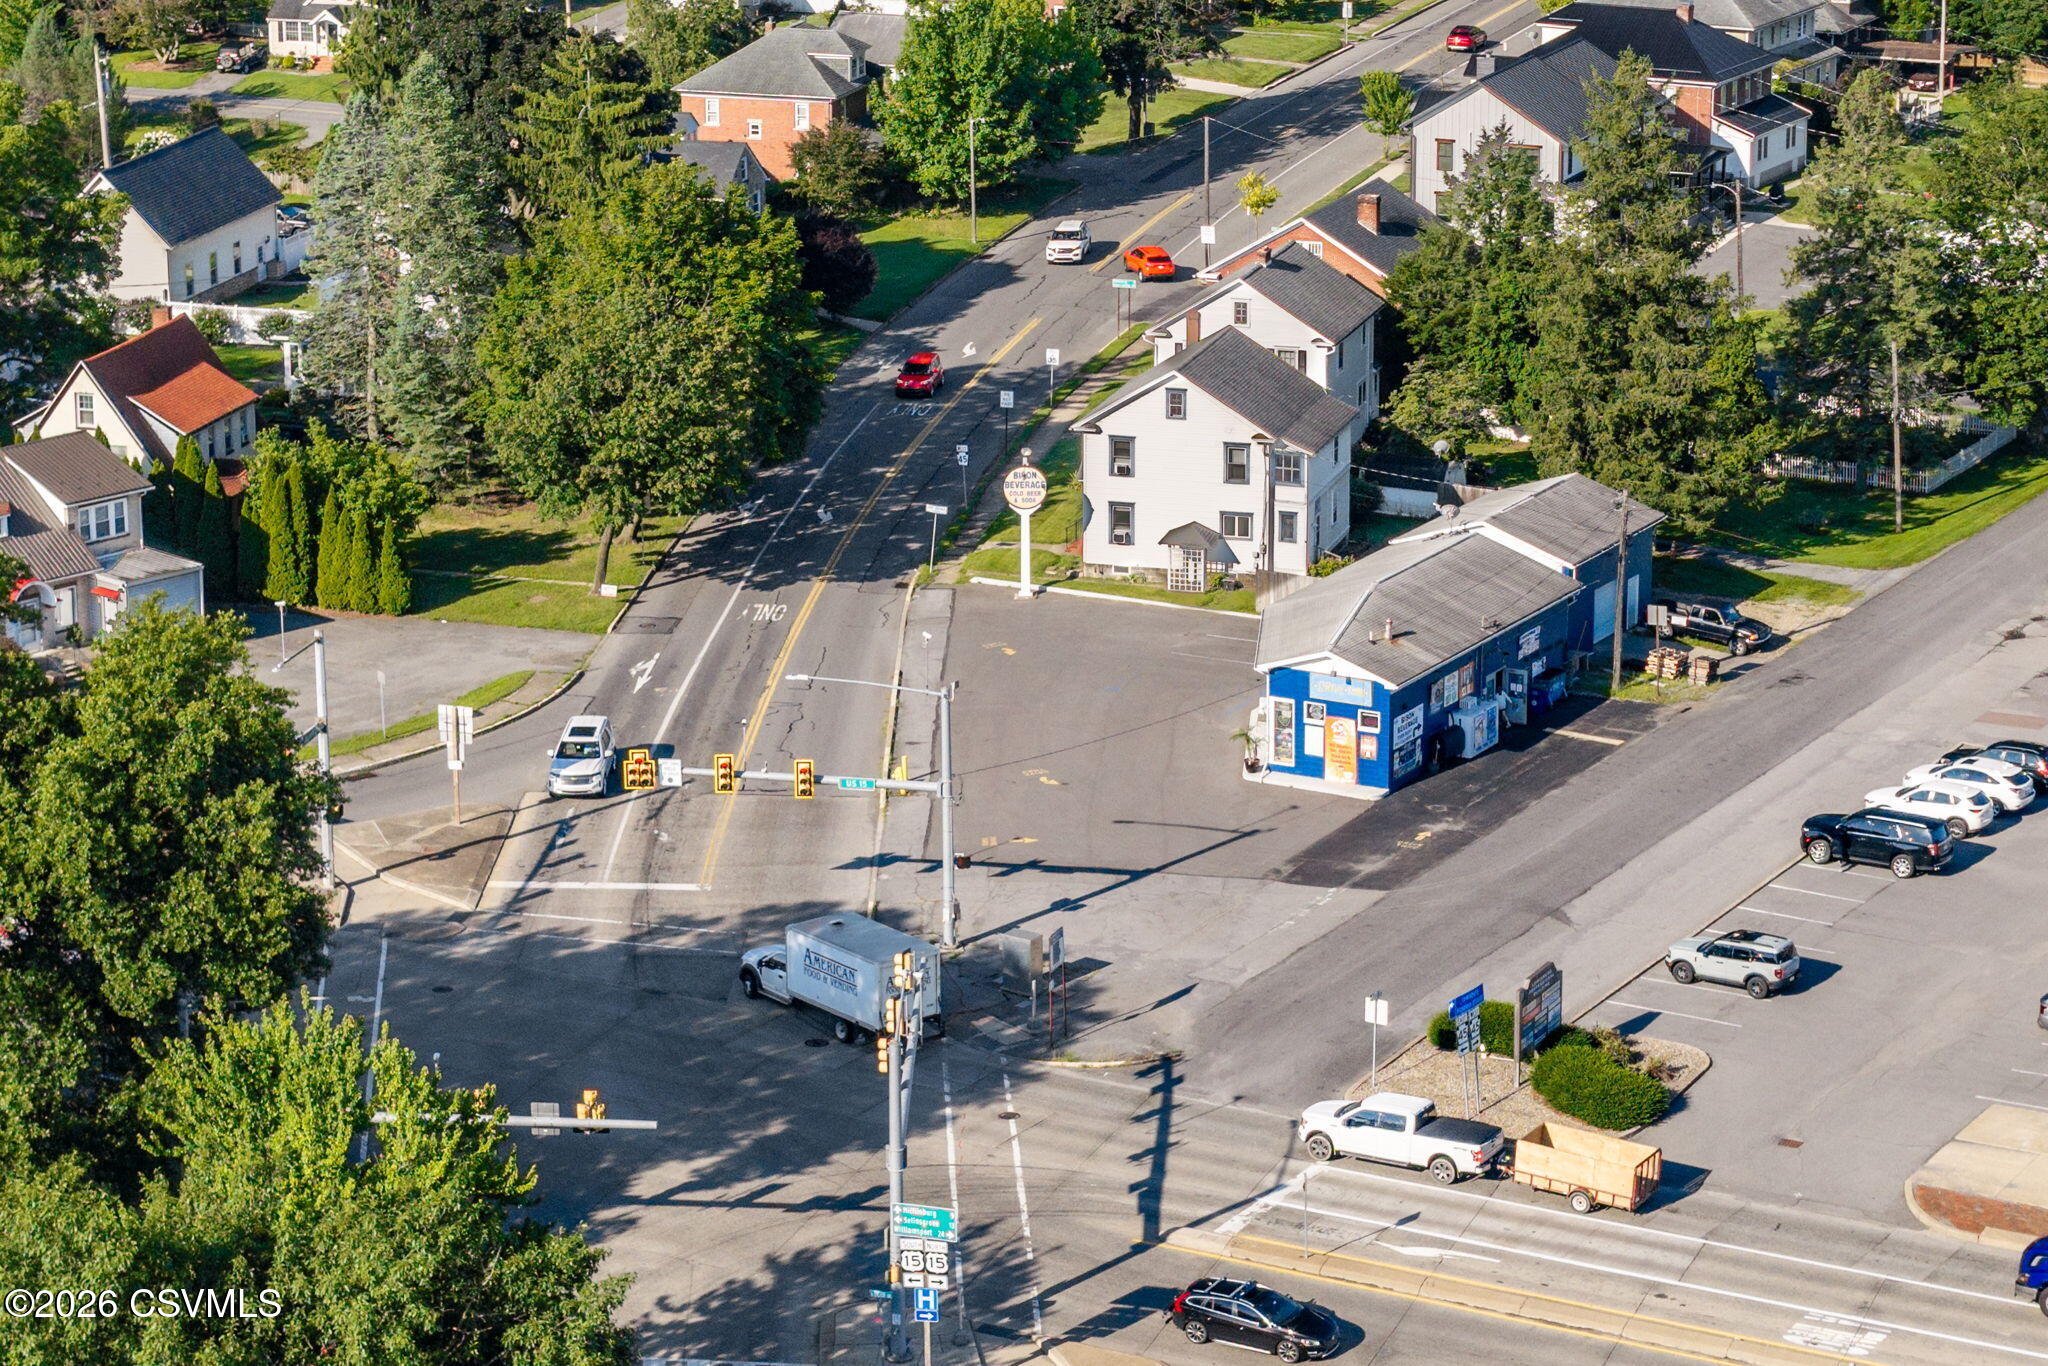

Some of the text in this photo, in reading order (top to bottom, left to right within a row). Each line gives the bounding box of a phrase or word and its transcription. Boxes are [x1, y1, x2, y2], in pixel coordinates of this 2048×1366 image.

[959, 455, 968, 463] 45
[846, 780, 857, 788] US
[803, 947, 856, 983] AMERICAN
[803, 966, 820, 982] FOOD
[830, 977, 857, 997] VENDING
[905, 1255, 921, 1267] 15
[929, 1257, 945, 1269] 15
[917, 1289, 935, 1310] H
